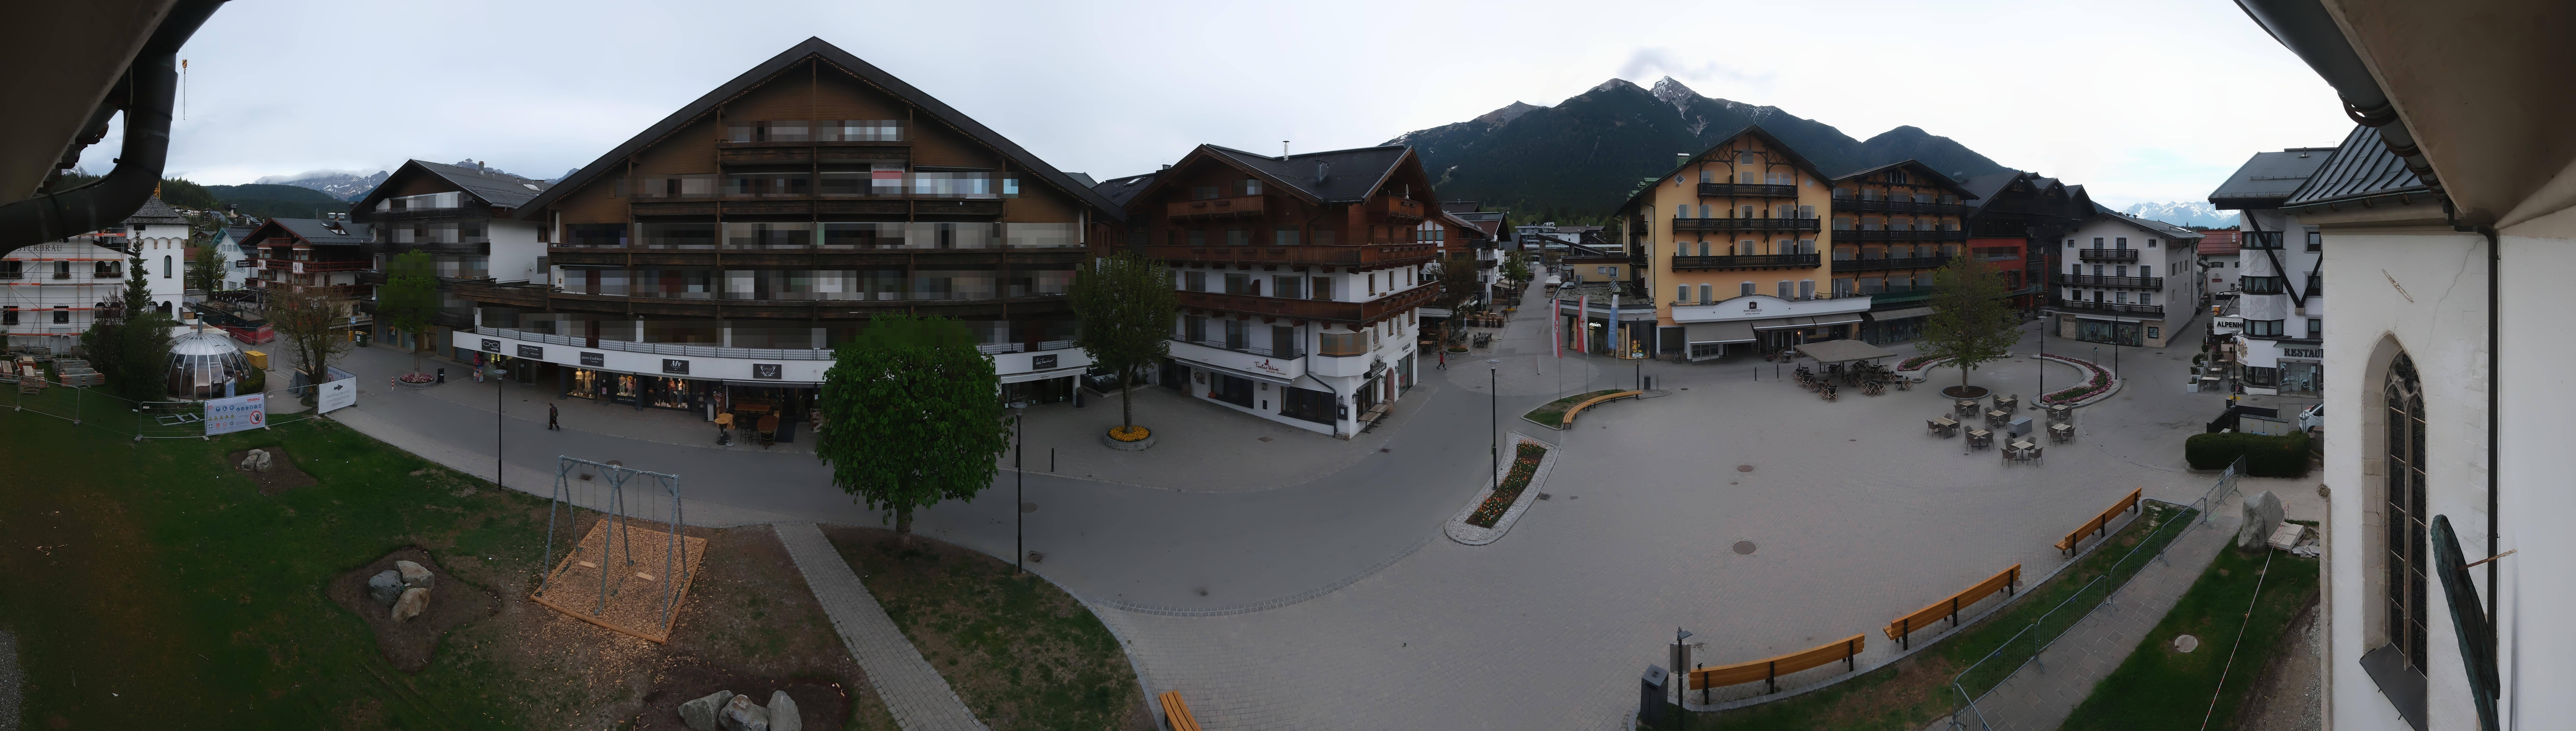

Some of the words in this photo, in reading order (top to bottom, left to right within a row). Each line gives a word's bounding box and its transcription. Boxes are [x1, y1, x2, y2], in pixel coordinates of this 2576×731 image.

[1402, 343, 1411, 352] SAILER
[1372, 364, 1385, 377] RESTAURANT
[326, 395, 349, 403] KONGRESSZENTRUM
